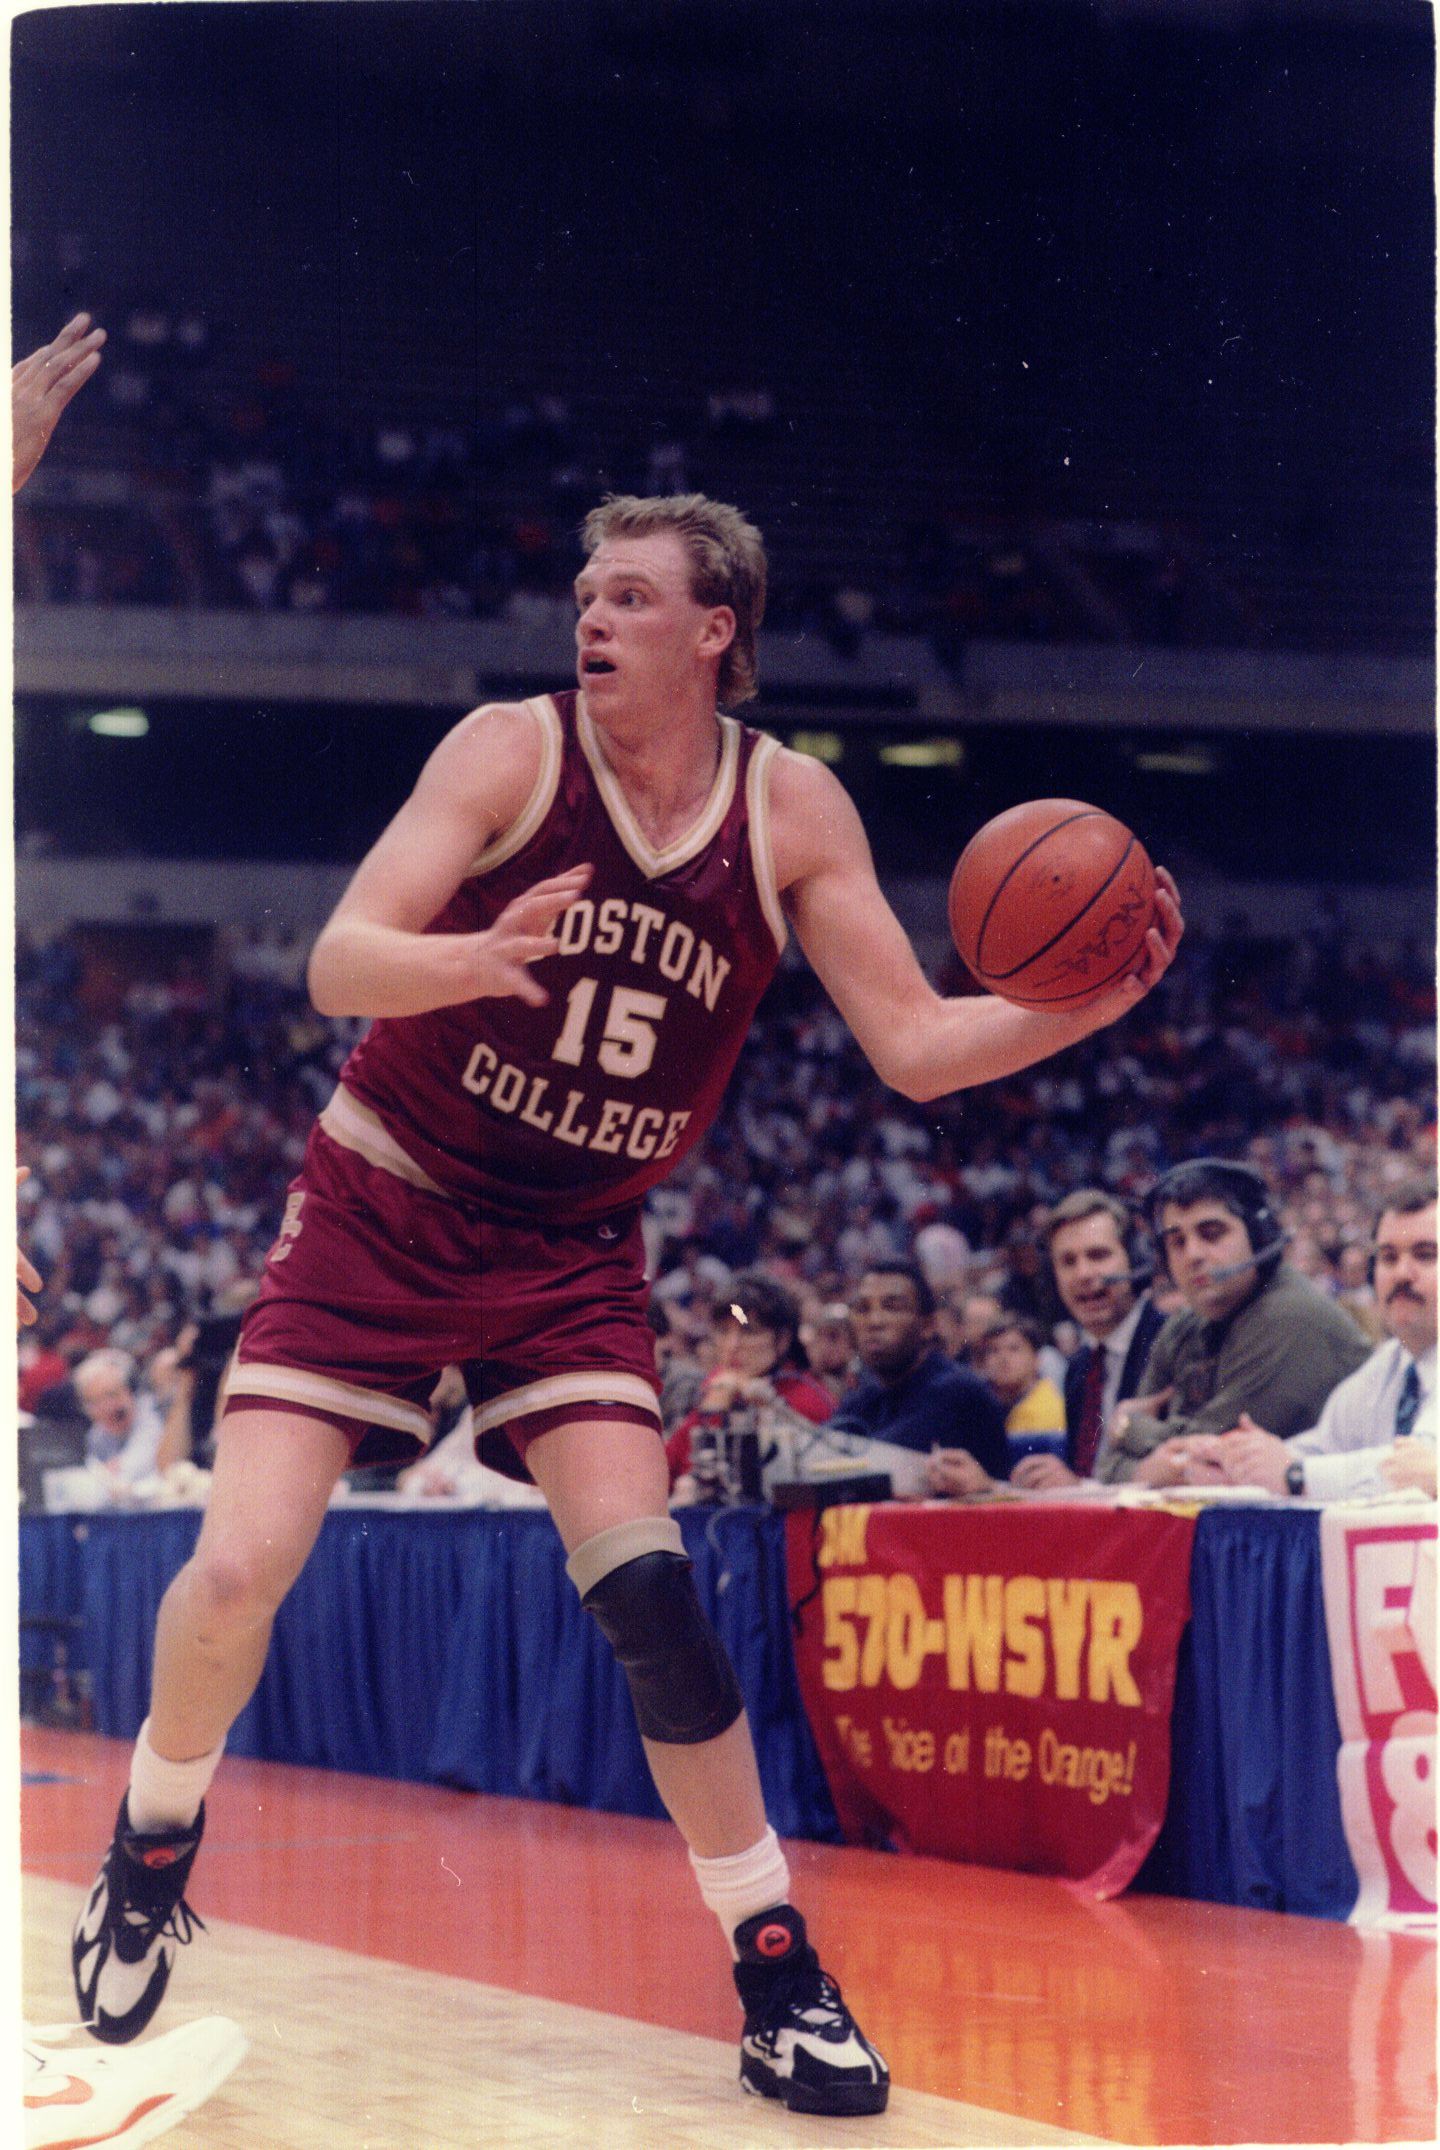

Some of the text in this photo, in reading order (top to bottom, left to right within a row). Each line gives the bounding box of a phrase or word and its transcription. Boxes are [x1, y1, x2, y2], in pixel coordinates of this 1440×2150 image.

[551, 899, 731, 1012] OSTON
[552, 977, 668, 1079] 15
[461, 1043, 692, 1160] COLLEGE
[821, 1573, 1144, 1708] 570-WSYR
[984, 1724, 1031, 1782] the
[1039, 1728, 1137, 1805] Orange!
